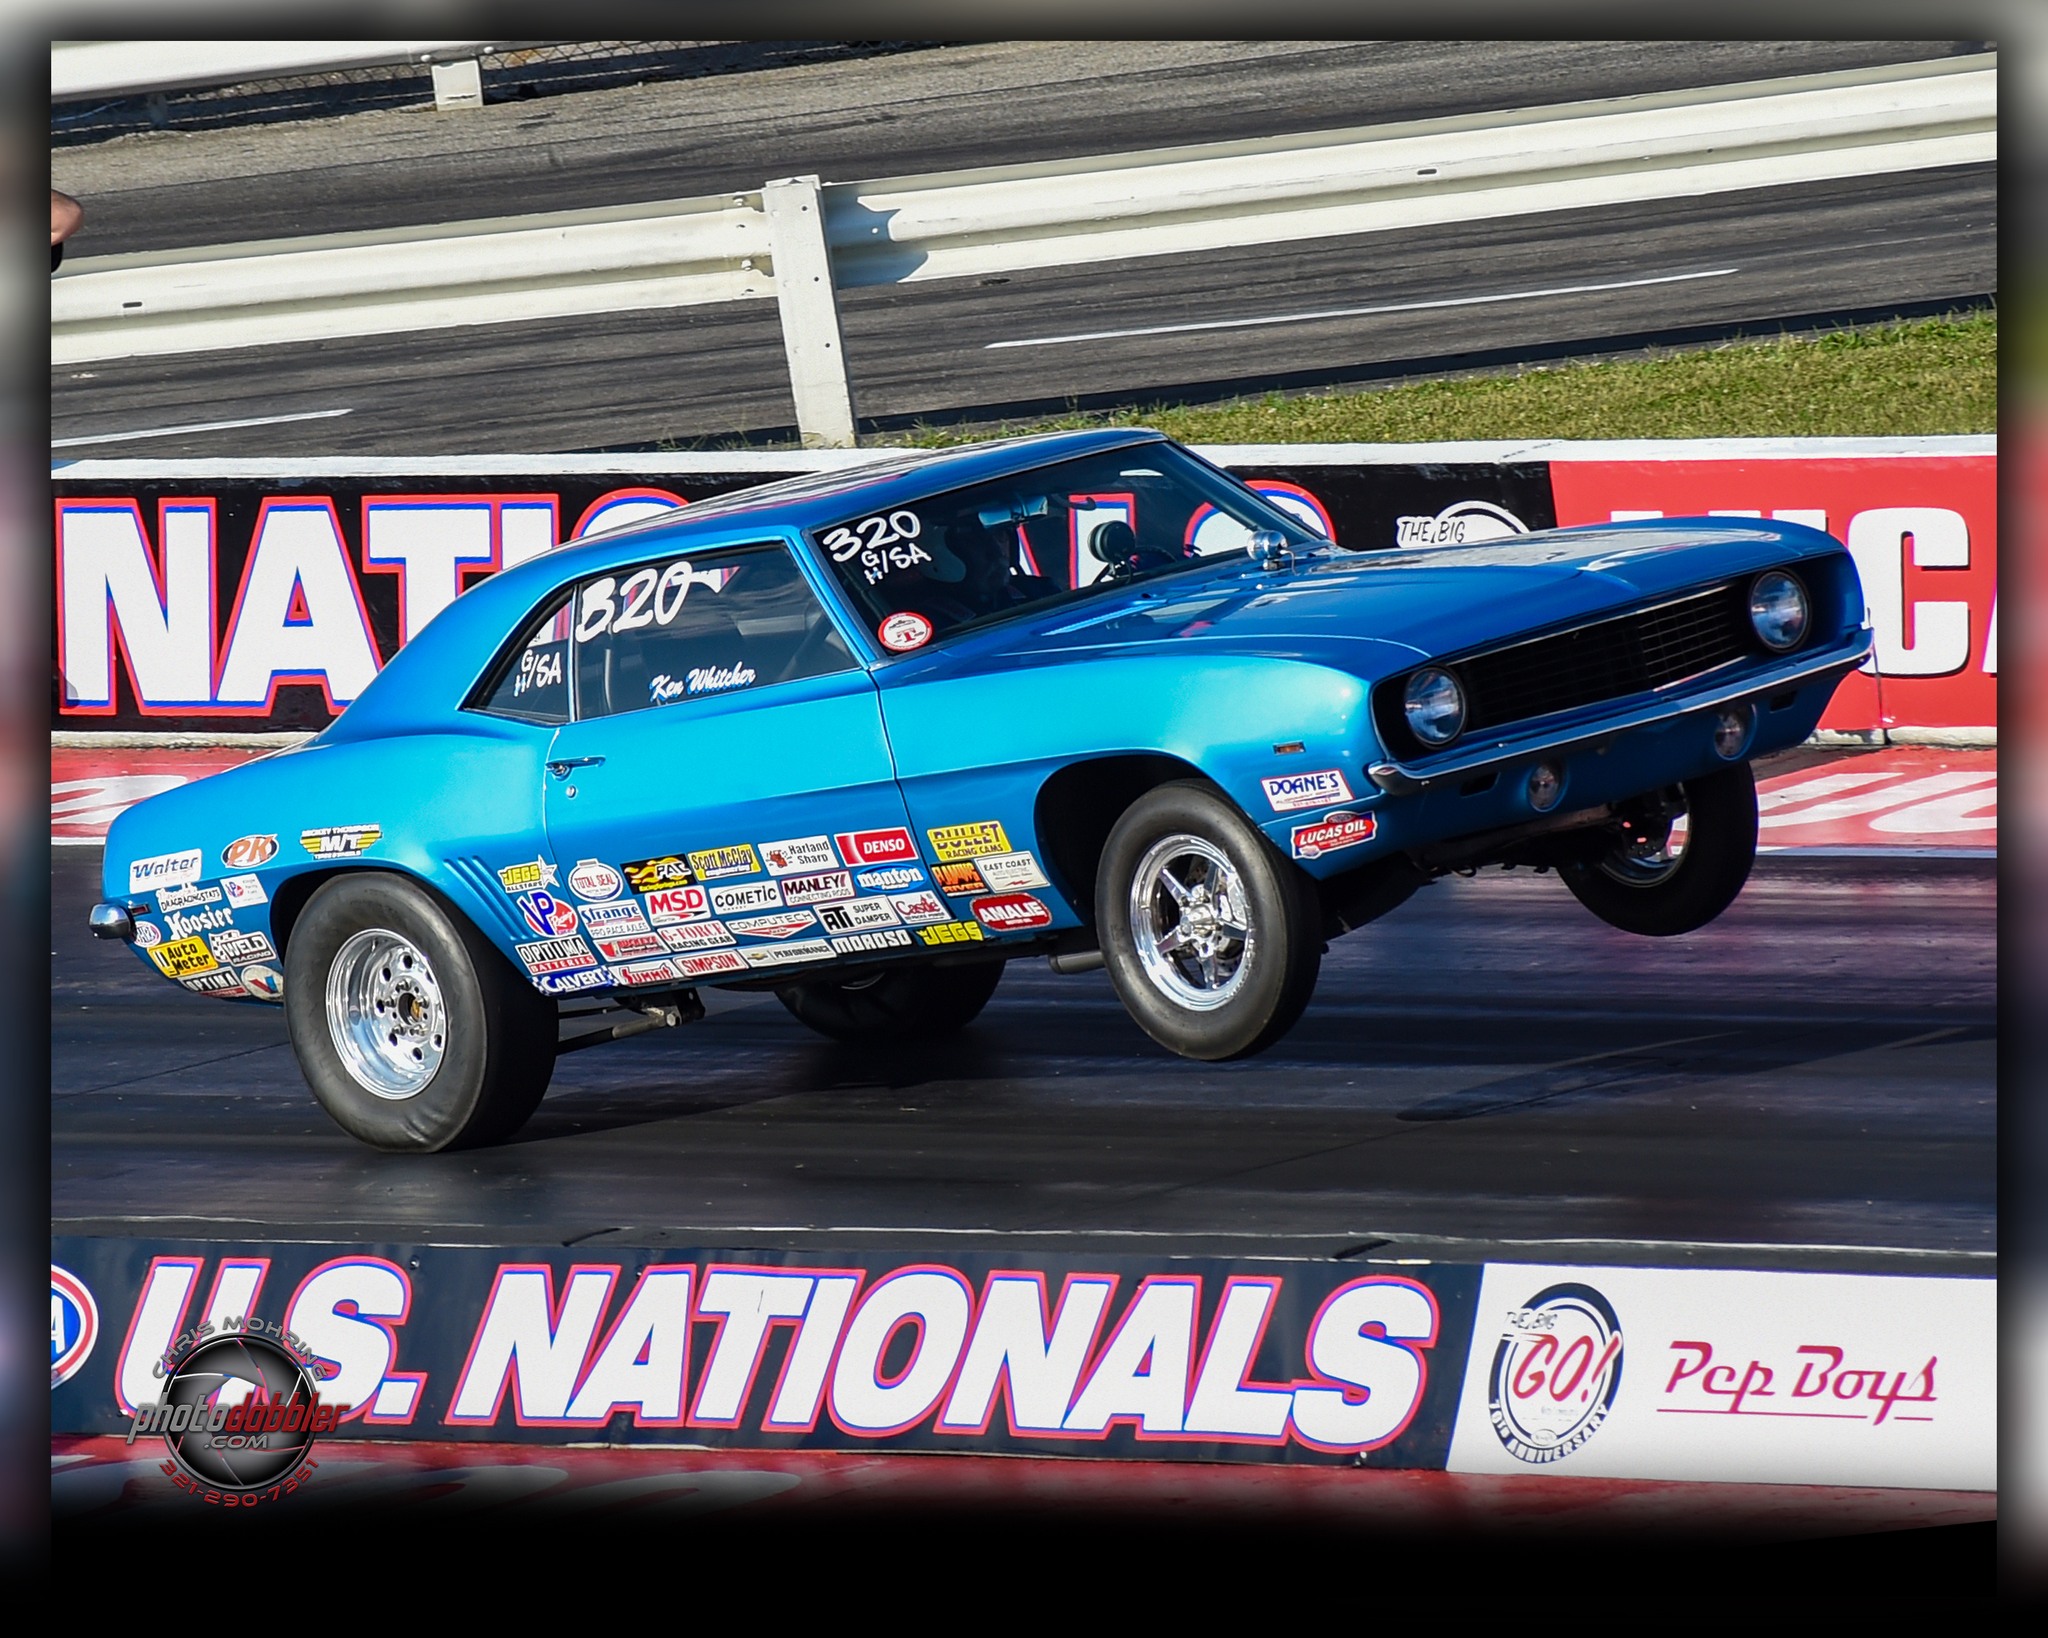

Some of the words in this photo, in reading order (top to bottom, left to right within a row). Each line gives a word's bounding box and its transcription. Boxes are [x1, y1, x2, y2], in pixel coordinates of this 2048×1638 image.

[823, 511, 921, 562] 320
[1400, 521, 1431, 542] THE
[1438, 521, 1465, 543] BIG
[650, 675, 683, 702] Ken
[687, 661, 756, 693] Whitcher
[1269, 773, 1339, 795] DOANE'S
[933, 823, 999, 849] BULLET
[1300, 825, 1342, 845] LUCAS
[1345, 820, 1366, 834] OIL
[320, 834, 363, 852] M/T
[789, 841, 829, 855] Harland
[863, 838, 905, 855] DENSO
[946, 848, 977, 858] RACING
[980, 843, 1003, 853] CAMS
[133, 857, 198, 878] Walter
[692, 850, 718, 870] Scott
[720, 847, 753, 867] McClay
[798, 854, 828, 865] Sharp
[983, 862, 1003, 871] EAST
[1005, 859, 1031, 869] COAST
[502, 864, 539, 886] JEGS
[656, 862, 691, 878] PAC
[857, 868, 924, 888] manton
[574, 877, 595, 889] TOTAL
[596, 874, 615, 886] SEAL
[784, 875, 840, 895] MANLEY
[650, 889, 703, 914] MSD
[715, 885, 777, 907] COMETIC
[519, 892, 555, 935] VP
[581, 904, 640, 921] Strange
[853, 903, 881, 913] SUPER
[978, 901, 1047, 922] AMALIE
[164, 905, 234, 941] Hoosier
[606, 925, 626, 935] RACE
[627, 922, 649, 933] AXLES
[729, 913, 813, 931] COMPUTECH
[819, 906, 854, 931] ATI
[854, 913, 893, 925] DAMPER
[661, 922, 726, 942] G-FORCE
[832, 930, 912, 953] MOROSO
[917, 921, 983, 946] JEGS
[167, 943, 198, 960] Auto
[221, 937, 267, 957] WELD
[518, 937, 590, 963] OPTIMA
[671, 938, 706, 950] RACING
[708, 935, 733, 947] GEAR
[171, 954, 210, 975] Meter
[233, 951, 272, 964] RACING
[530, 956, 594, 973] BATTERIES
[682, 953, 739, 973] SIMPSON
[185, 972, 239, 991] OPTIMA
[544, 969, 605, 993] CALVERT
[115, 1257, 427, 1424] U.S.
[446, 1264, 1440, 1453] NATIONALS
[1513, 1335, 1620, 1403] GO!
[1791, 1345, 1937, 1426] Boys
